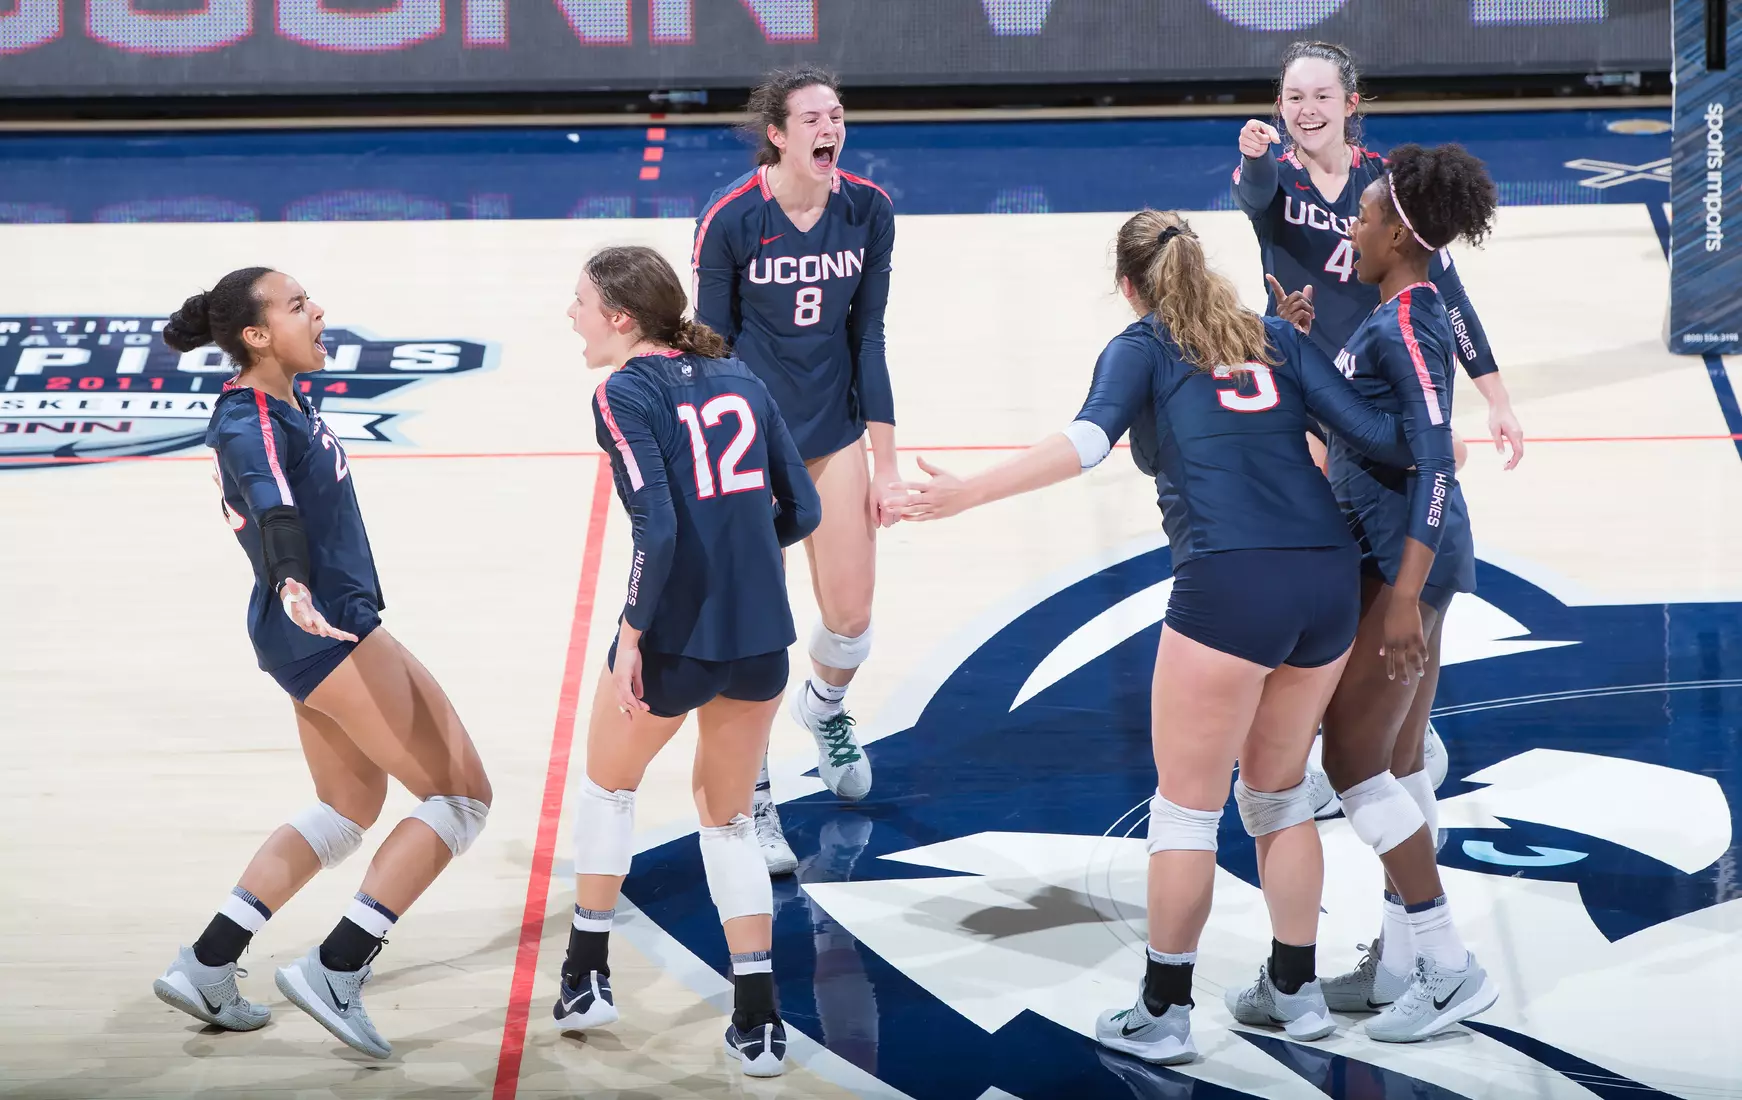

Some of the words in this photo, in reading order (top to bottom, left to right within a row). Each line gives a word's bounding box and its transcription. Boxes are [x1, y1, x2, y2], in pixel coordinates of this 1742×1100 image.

[1704, 102, 1725, 169] sports
[1284, 196, 1359, 237] UCO
[1702, 171, 1724, 252] imports
[749, 248, 865, 285] UCONN
[1324, 238, 1354, 283] 4
[794, 286, 822, 327] 8
[1448, 306, 1477, 361] HUSKIES
[45, 376, 164, 390] 2011
[676, 392, 766, 500] 12
[1427, 472, 1446, 528] HUSKIES
[627, 549, 646, 607] HUSKIES
